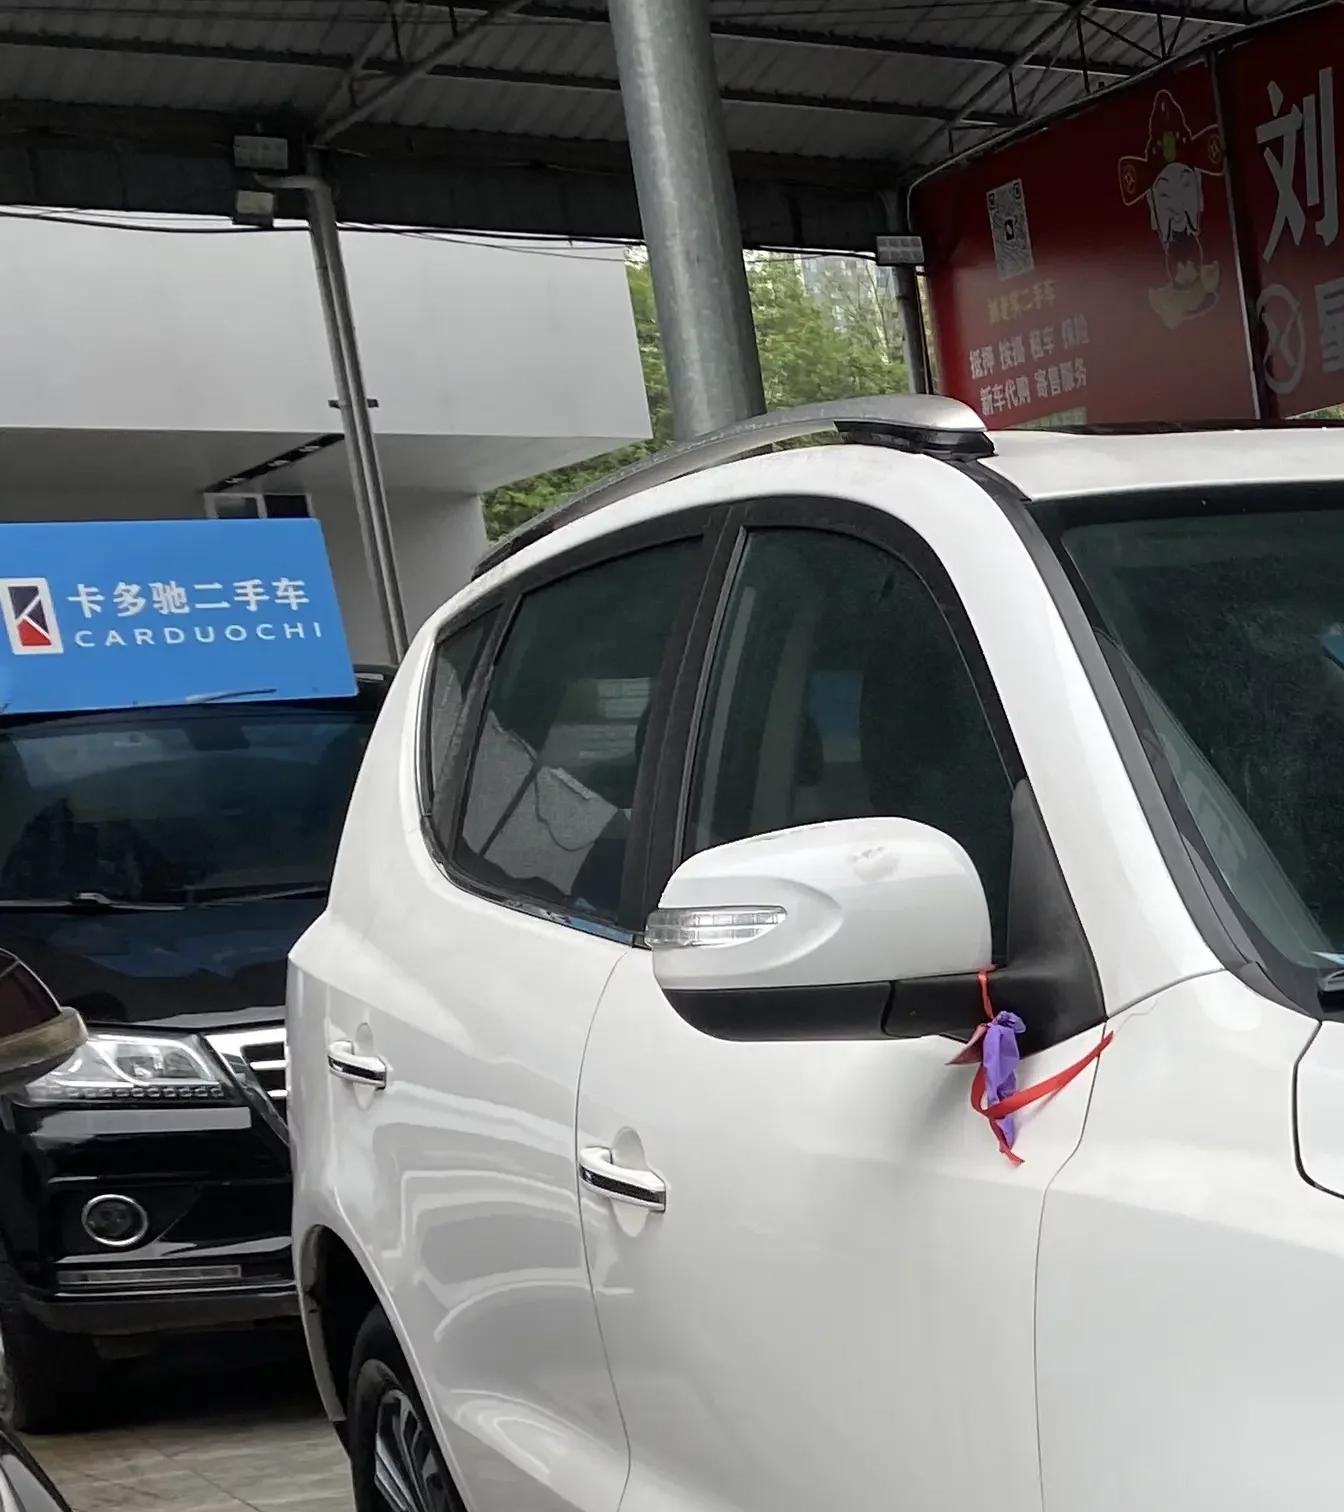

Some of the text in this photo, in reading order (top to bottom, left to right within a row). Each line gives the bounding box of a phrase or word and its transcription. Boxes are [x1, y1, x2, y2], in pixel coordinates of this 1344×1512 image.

[68, 577, 310, 619] 卡多驰二手车
[75, 622, 322, 648] CARDUOCHI
